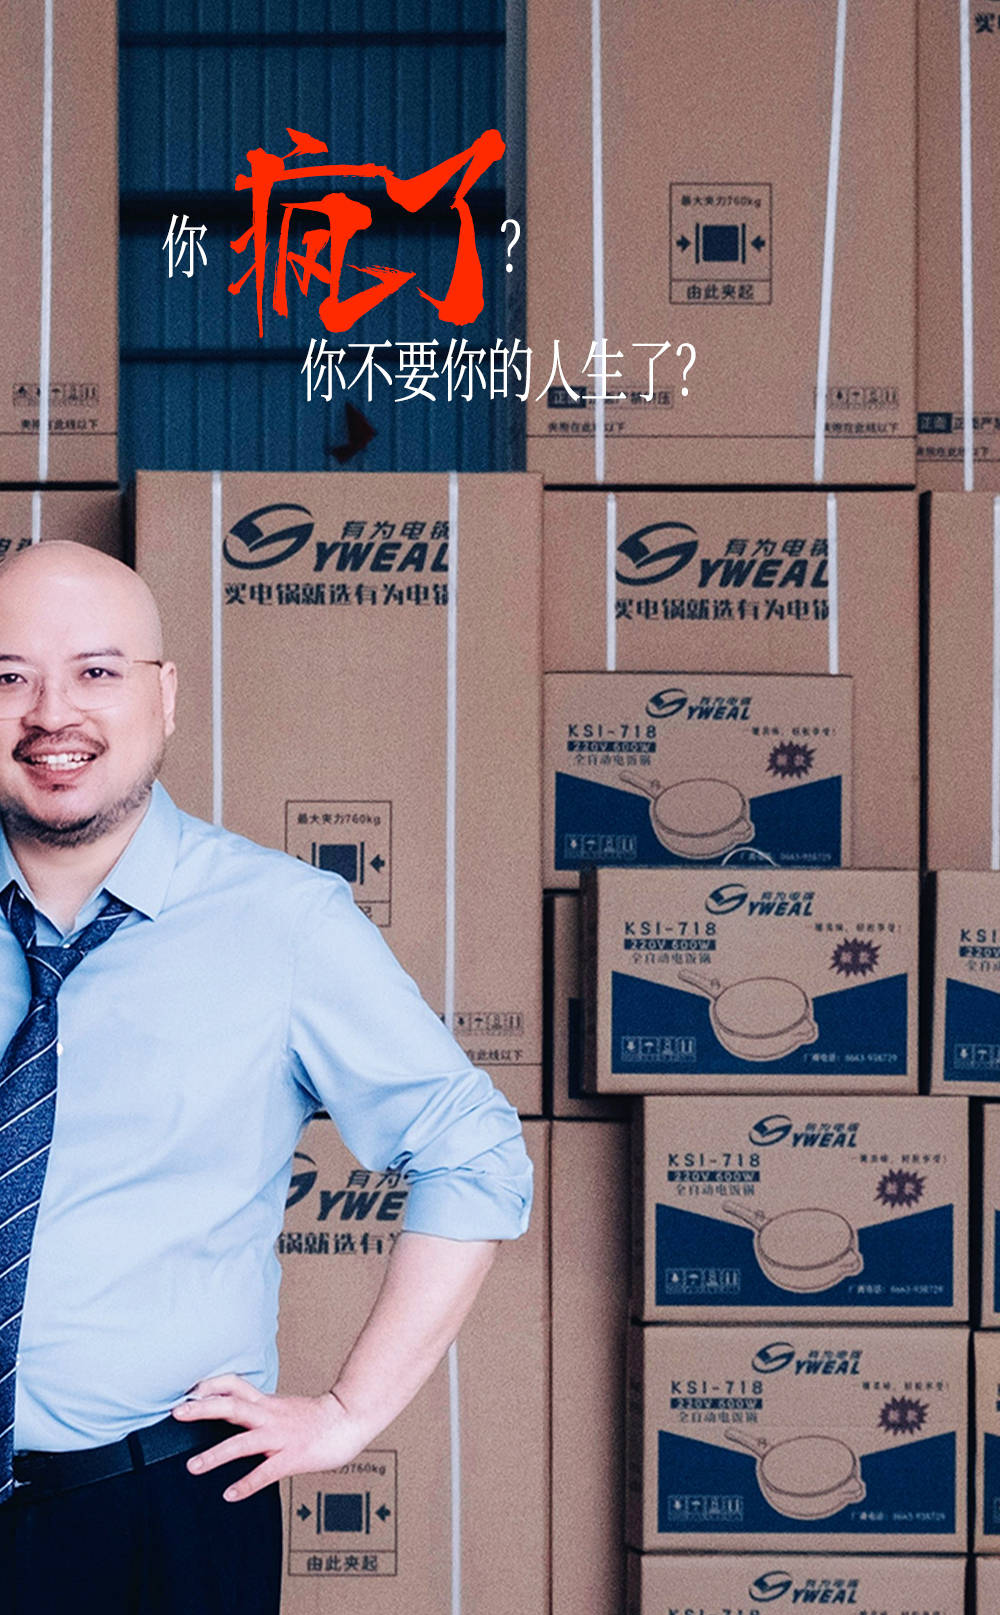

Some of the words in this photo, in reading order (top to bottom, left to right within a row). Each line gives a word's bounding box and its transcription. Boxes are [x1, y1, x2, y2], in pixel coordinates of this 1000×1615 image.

[975, 12, 1000, 33] 买
[686, 284, 754, 300] 由此夹起
[686, 706, 750, 720] YWEAL
[568, 724, 657, 738] KSI-718
[748, 901, 813, 916] YWEAL
[625, 921, 717, 936] KSI-718
[960, 928, 1000, 943] KSI
[792, 1132, 858, 1148] YWEAL
[668, 1152, 760, 1168] KSI-718
[346, 1169, 402, 1189] 有为
[317, 1190, 409, 1222] YWE
[794, 1360, 861, 1375] YWEAL
[671, 1380, 763, 1395] KSI-718
[307, 1555, 378, 1571] 由此夹起
[791, 1588, 858, 1604] YWEAL
